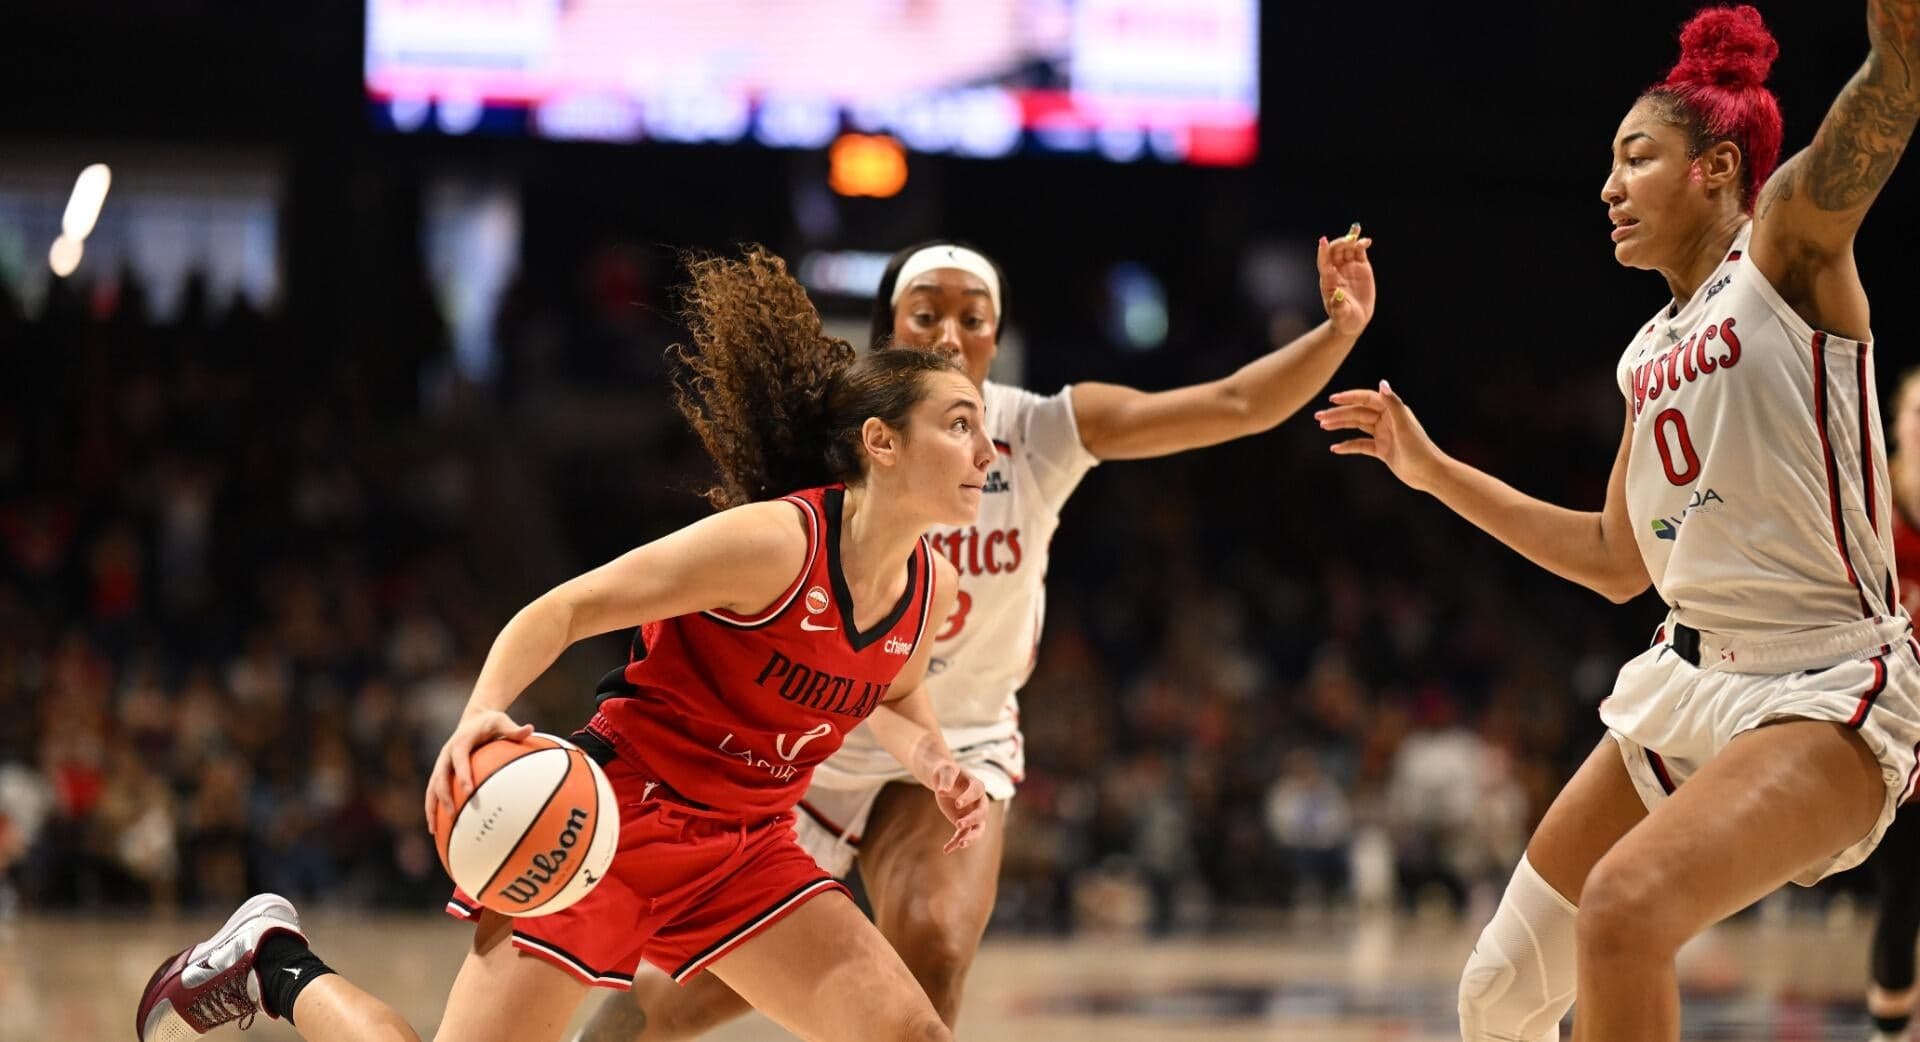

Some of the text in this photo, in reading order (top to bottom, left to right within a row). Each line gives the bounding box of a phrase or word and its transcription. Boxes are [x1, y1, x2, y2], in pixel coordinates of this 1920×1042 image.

[1632, 317, 1742, 421] ystics
[1654, 408, 1700, 486] 0
[754, 651, 891, 718] PORTLAN
[499, 807, 588, 904] Wilson
